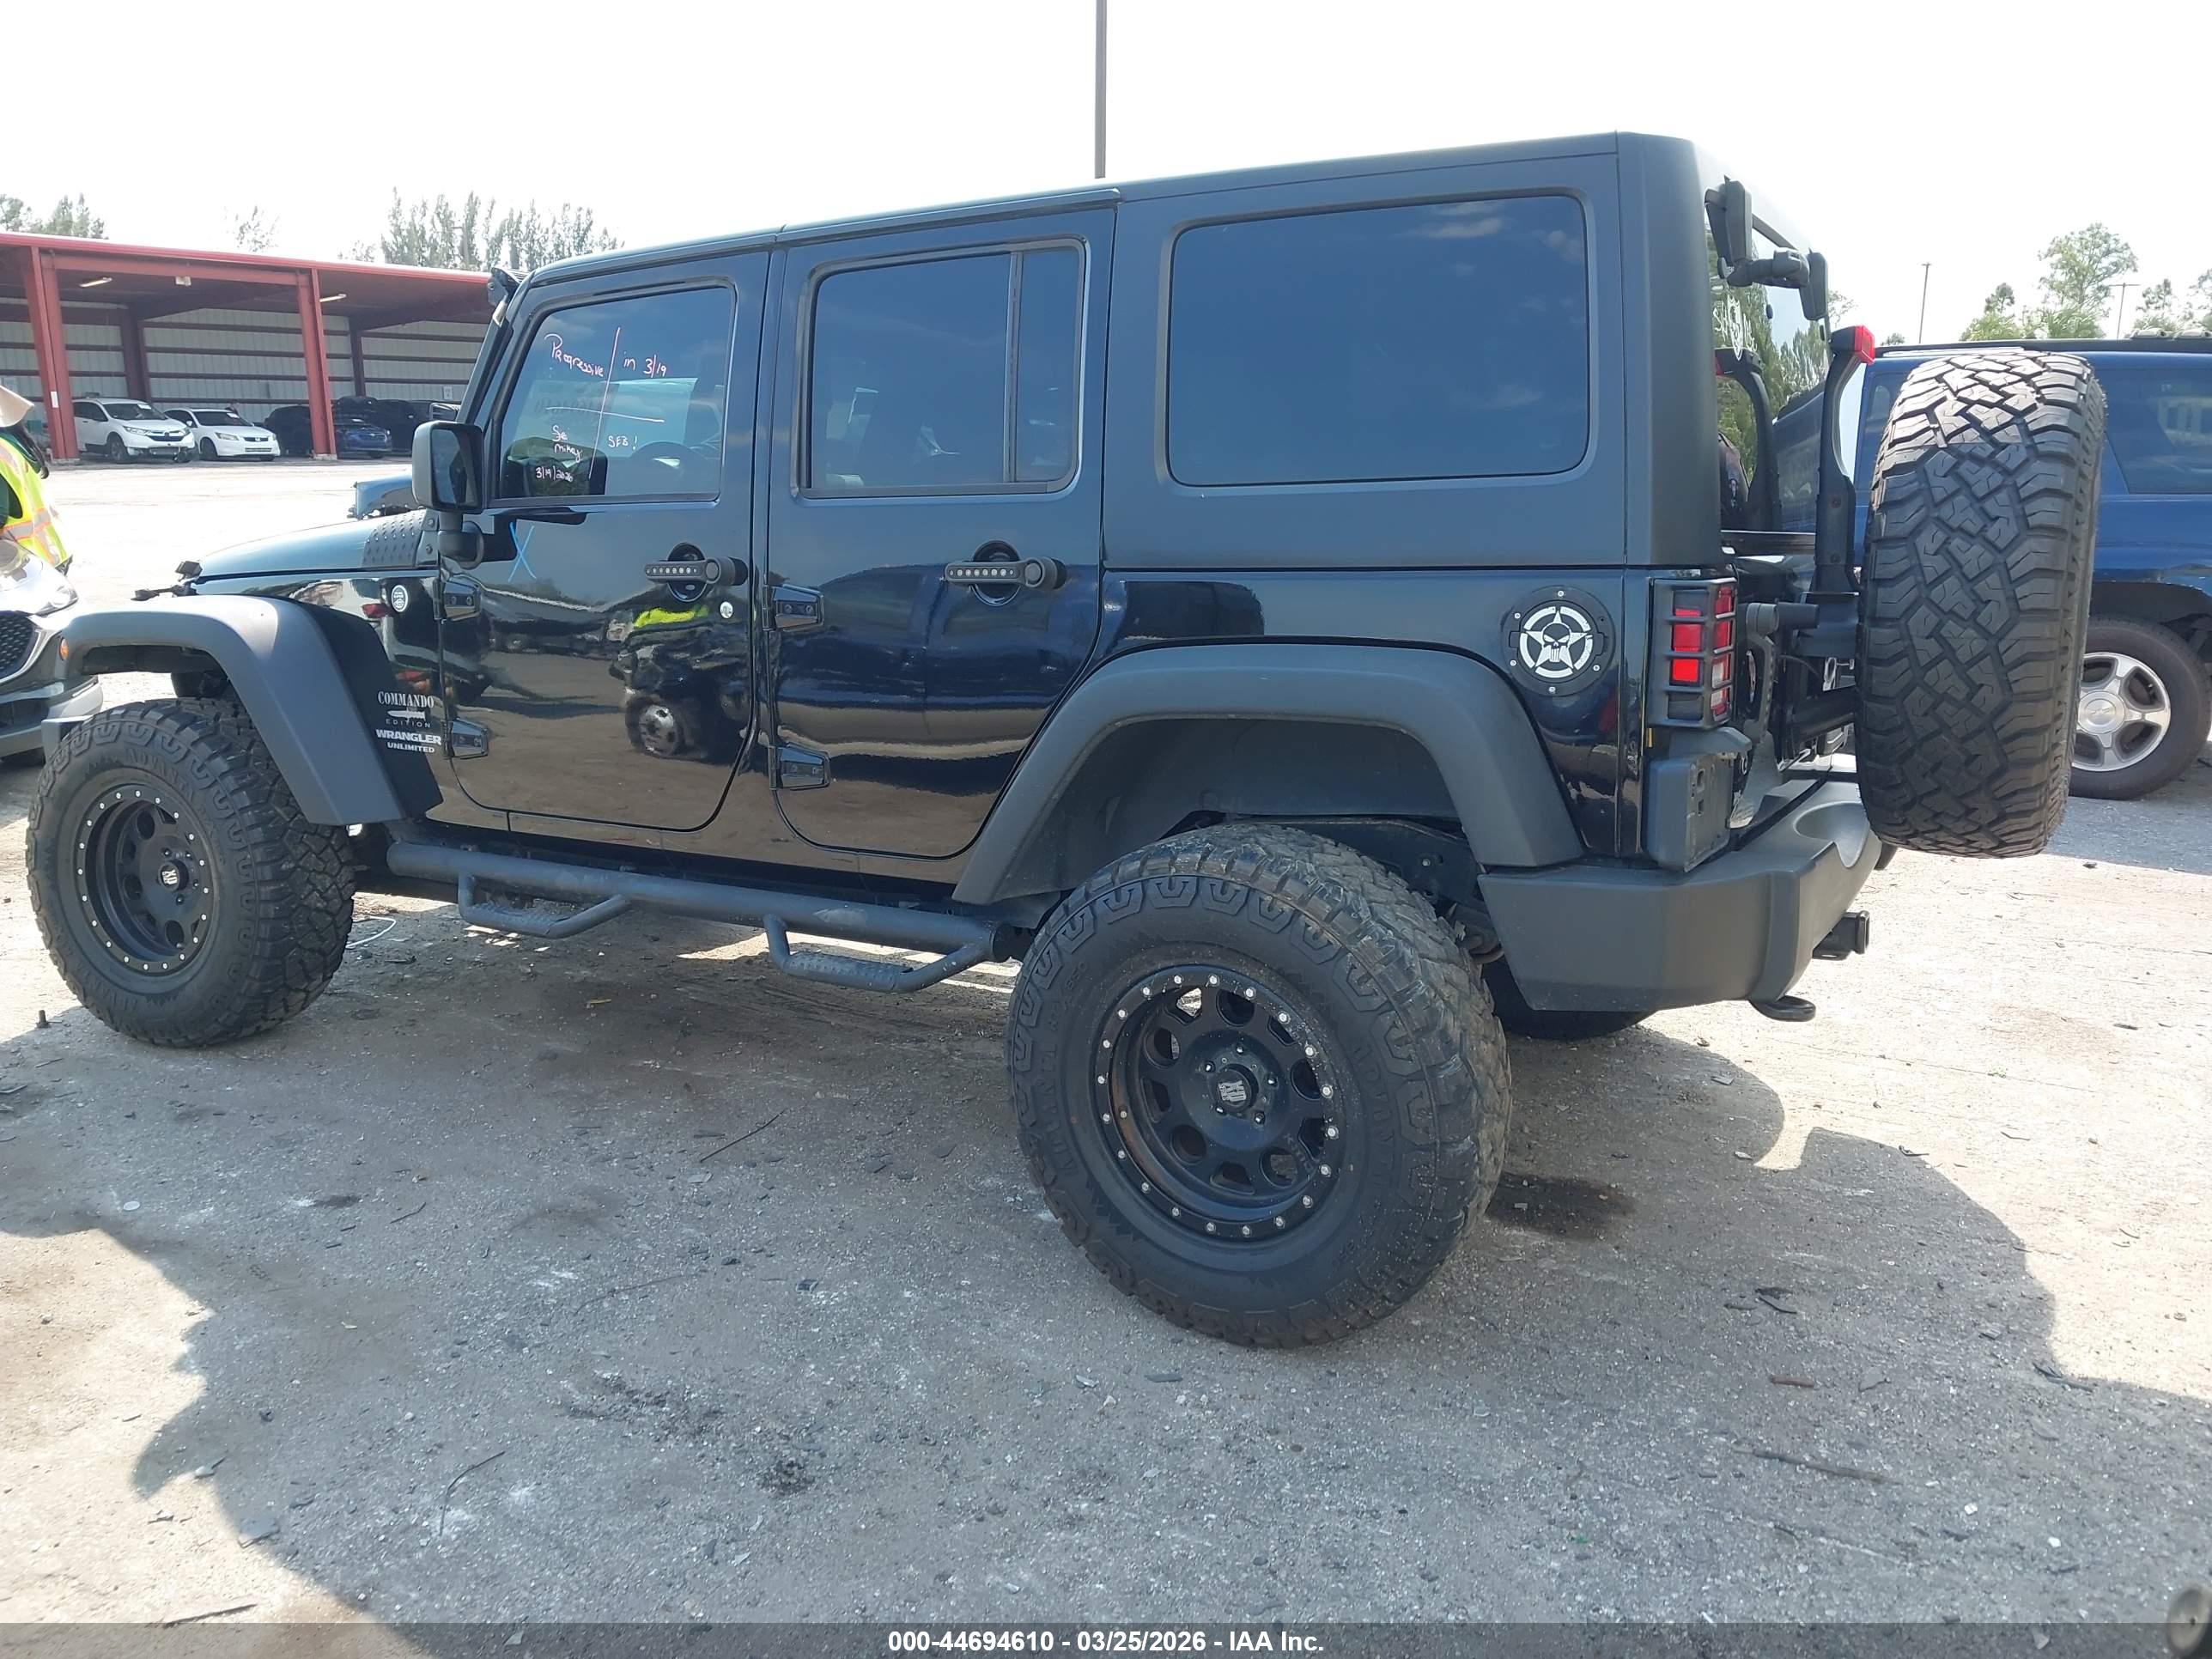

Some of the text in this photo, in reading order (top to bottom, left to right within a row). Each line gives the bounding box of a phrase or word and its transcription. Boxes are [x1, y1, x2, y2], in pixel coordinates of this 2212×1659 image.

[623, 351, 667, 379] in 3/19
[377, 690, 434, 708] COMMANDO
[385, 718, 431, 728] EDITION
[375, 728, 442, 745] WRANGLER
[387, 741, 435, 753] UNLIMITED
